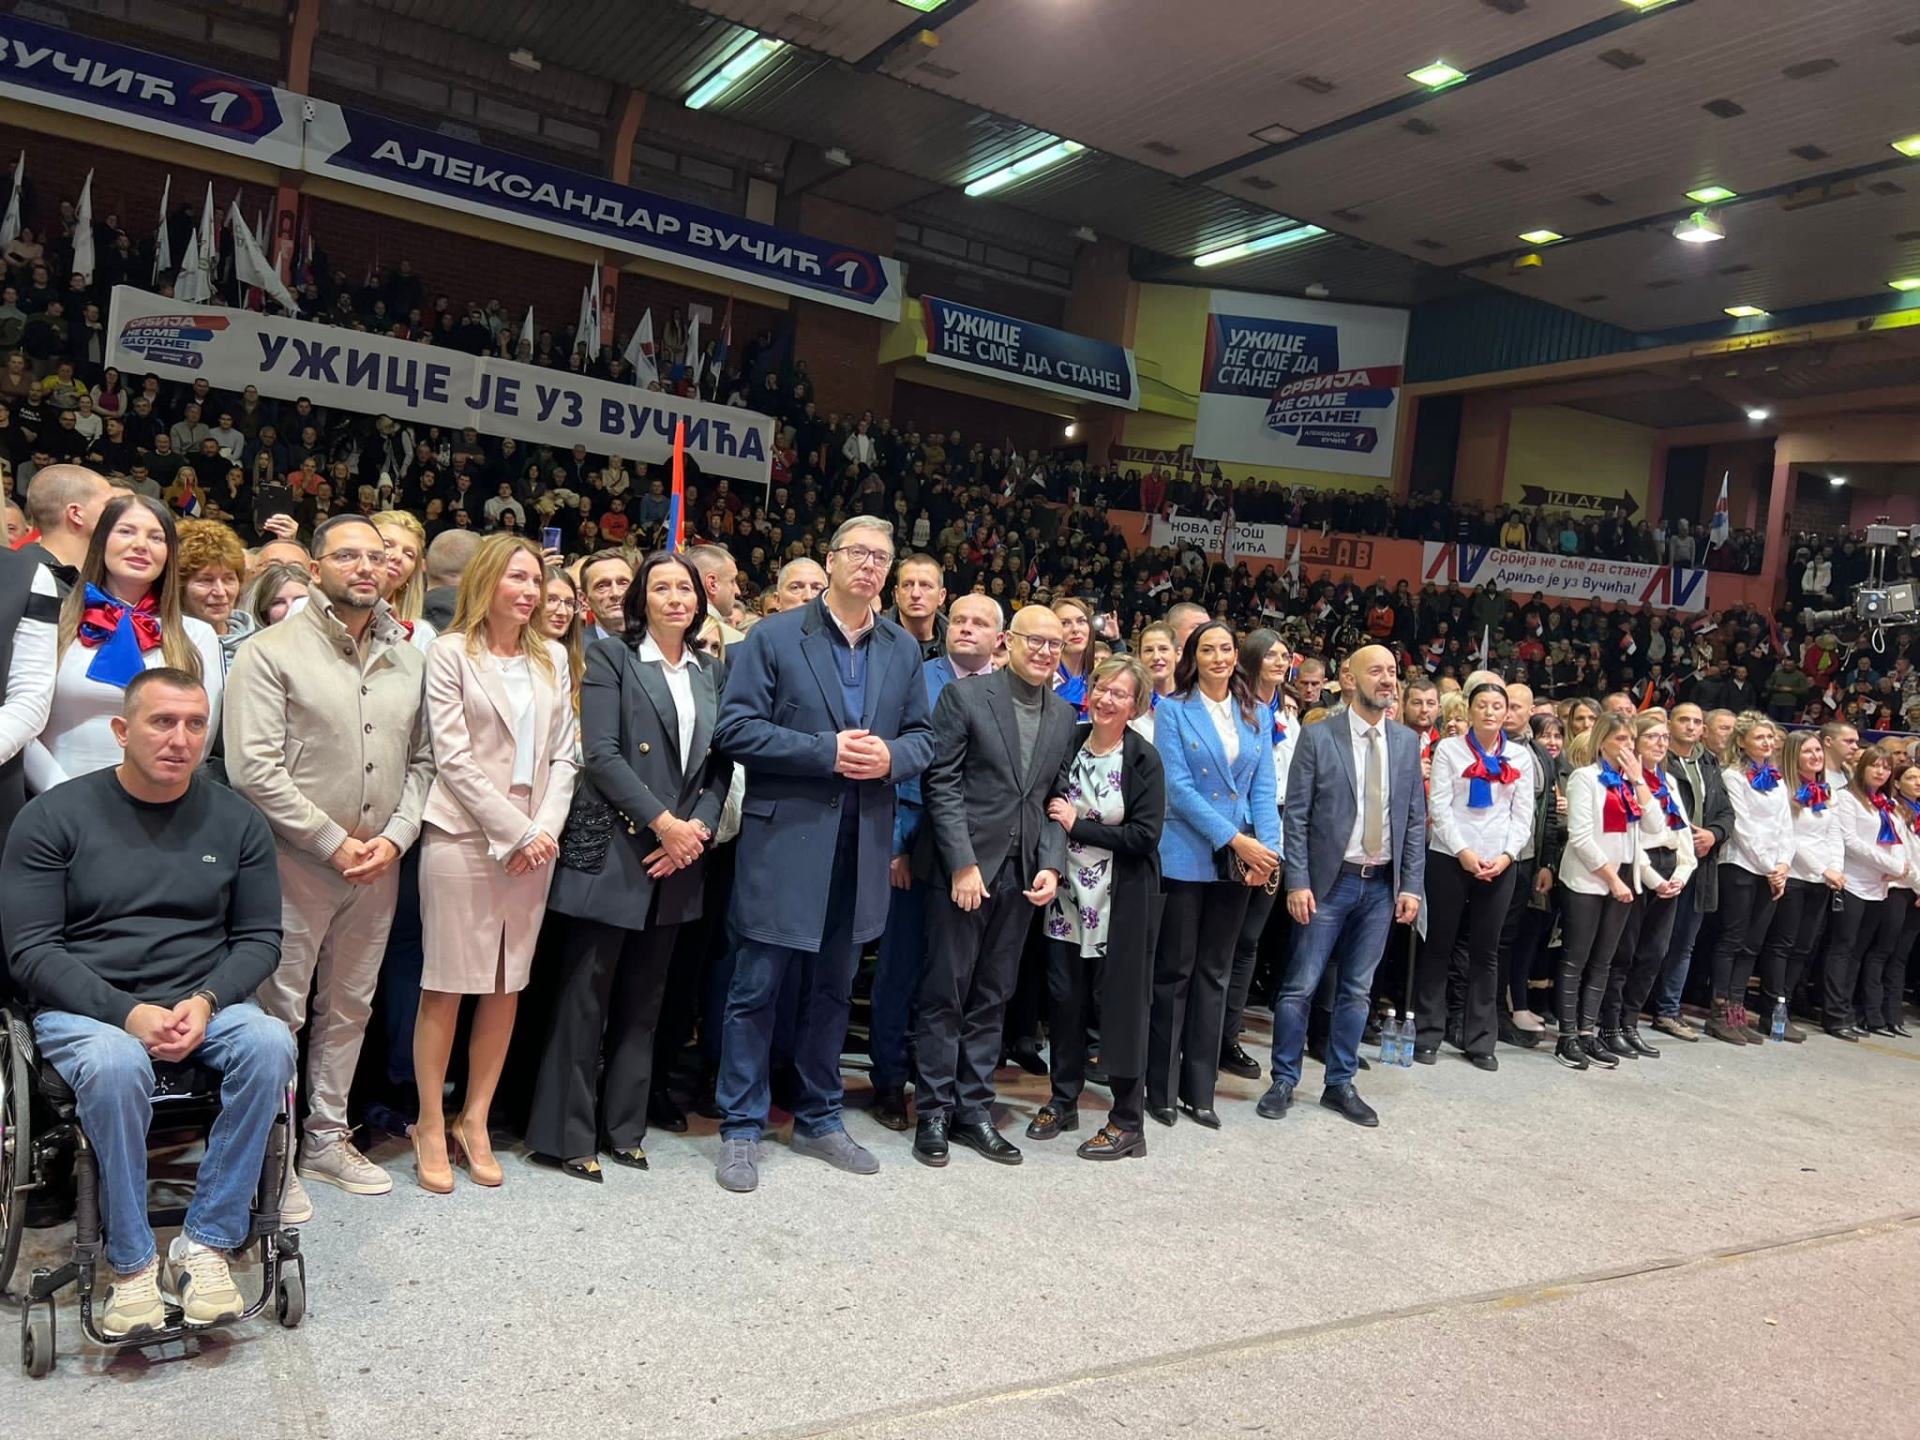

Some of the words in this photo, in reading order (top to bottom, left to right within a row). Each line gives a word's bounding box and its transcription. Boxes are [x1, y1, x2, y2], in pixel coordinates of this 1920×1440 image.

[200, 91, 239, 123] 1
[371, 139, 681, 236] АЛЕКСАНДАР
[687, 221, 821, 276] ВУЧИЋ
[835, 260, 859, 288] 1
[126, 328, 141, 337] НЕ
[142, 328, 181, 338] СМЕ
[130, 316, 196, 328] СРБИЈА
[942, 307, 1021, 348] УЖИЦЕ
[137, 337, 190, 349] СТАНЕ!
[1229, 328, 1306, 354] УЖИЦЕ
[943, 331, 971, 356] НЕ
[975, 340, 1019, 367] СМЕ
[1022, 352, 1052, 376] ДА
[1056, 360, 1121, 392] СТАНЕ!
[1222, 347, 1249, 366] НЕ
[1251, 350, 1291, 371] СМЕ
[1291, 355, 1319, 374] ДА
[1217, 366, 1282, 389] СТАНЕ!
[1280, 370, 1371, 398] СРБИЈА
[257, 332, 451, 407] УЖИЦЕ
[464, 373, 520, 416] ЈЕ
[535, 384, 583, 428] УЗ
[600, 398, 765, 462] ВУЧИЋА
[1274, 398, 1296, 412] НЕ
[1296, 392, 1348, 407] СМЕ
[1268, 414, 1286, 426] ДА
[1287, 410, 1361, 424] СТАНЕ!
[1126, 448, 1180, 466] IZLAZ
[1547, 491, 1602, 510] IZLAZ
[1171, 522, 1209, 535] НОВА
[1489, 550, 1537, 568] Србија
[1540, 556, 1557, 568] не
[1559, 559, 1585, 571] сме
[1588, 562, 1606, 574] да
[1608, 565, 1652, 579] стане!
[1496, 568, 1545, 584] Ариље
[1546, 573, 1560, 587] је
[1561, 577, 1578, 590] уз
[1582, 576, 1636, 595] Вучића!
